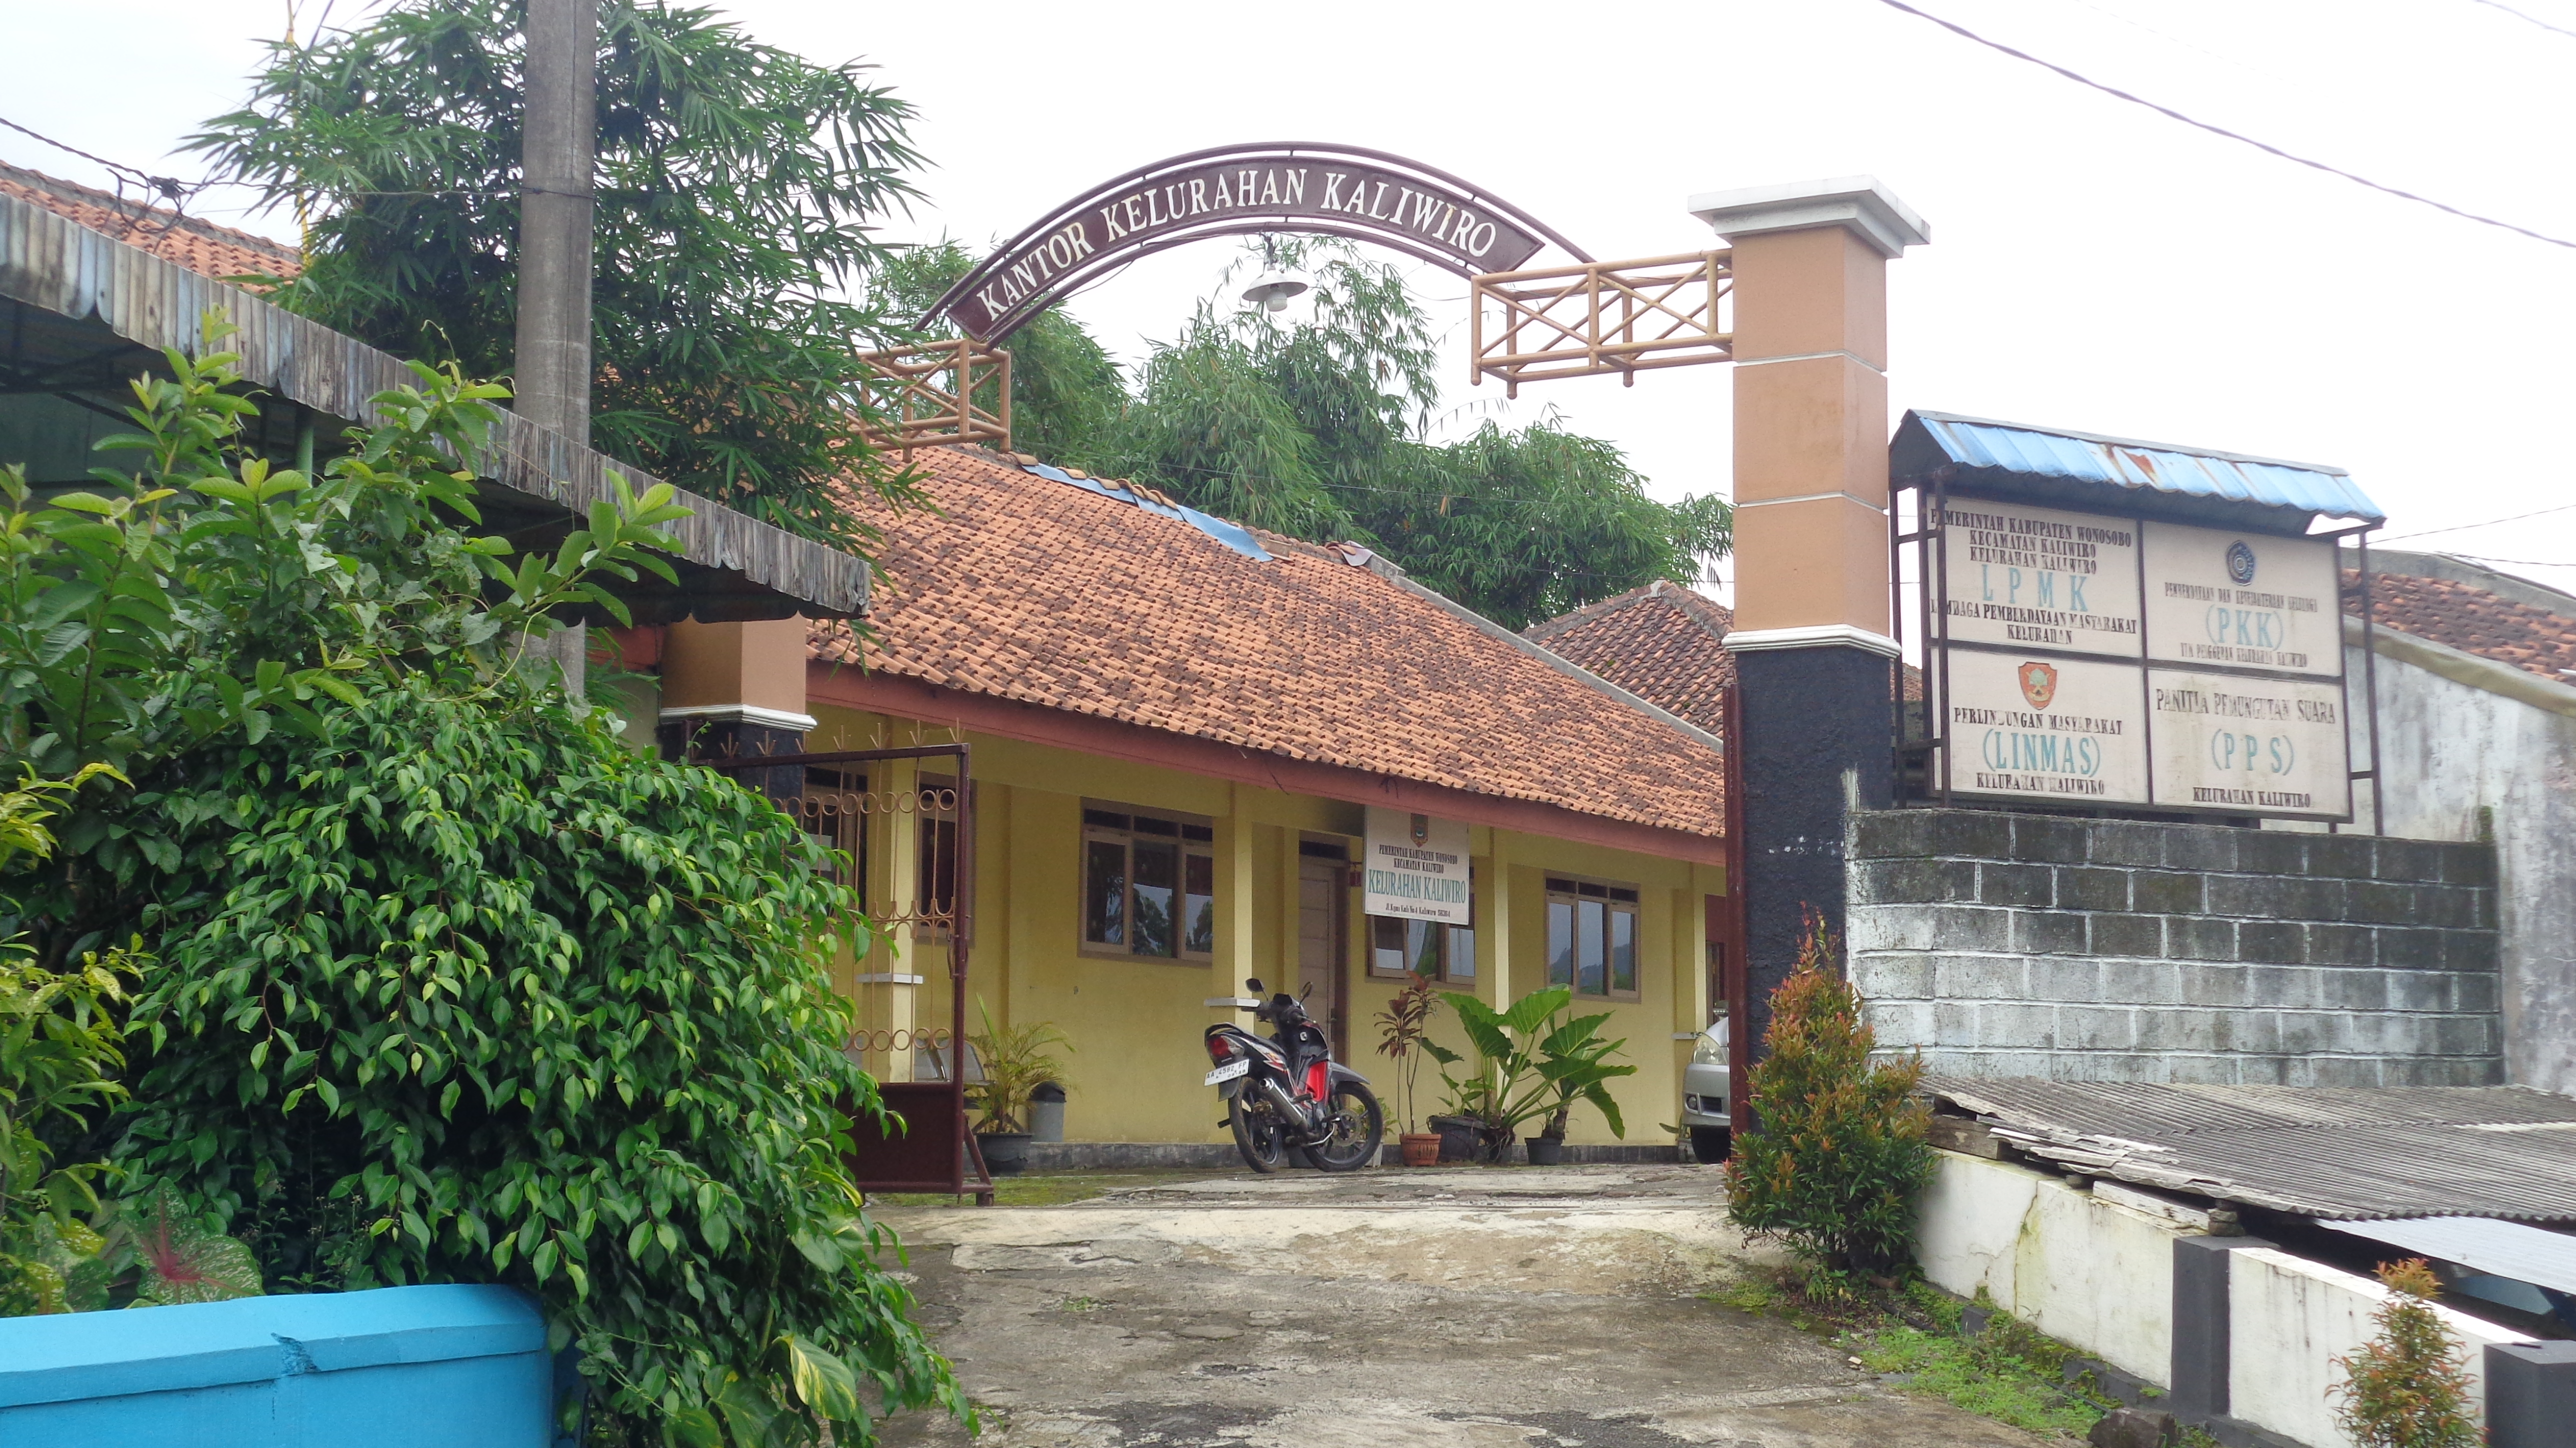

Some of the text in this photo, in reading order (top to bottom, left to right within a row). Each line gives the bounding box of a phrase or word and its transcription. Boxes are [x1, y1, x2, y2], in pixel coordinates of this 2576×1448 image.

[976, 168, 1498, 322] KANTOR KELURAHAN KALIWIRO
[1930, 509, 2132, 547] PMERINTAH KABUPATEN WONOSOBO
[1970, 530, 2096, 558] KECAMATAN KALIWIRO
[1970, 546, 2096, 574] KELURAHAN KALIWIRO
[1930, 598, 2136, 634] LMBAGA PEMBERDAYAAN MASYARAKAT
[2206, 604, 2284, 651] (PKK)
[2007, 624, 2072, 644] KELURAHAN
[2156, 688, 2336, 724] PANITIA PEMUNGUTAN SUARA
[2049, 715, 2122, 735] MASYARAKAT
[1982, 728, 2100, 778] (LINMAS)
[1976, 772, 2104, 795] KELURAHAN KALIWIRO
[2193, 786, 2310, 808] KELURAHAN KALIWIRO
[1379, 844, 1458, 864] PEMERINTAH KABUPATEN WONOSOBO
[1394, 858, 1444, 874] KECAMATAN KALIWIRO
[1368, 868, 1466, 904] KELURAHAN KALIWIRO
[1238, 1061, 1247, 1069] FP
